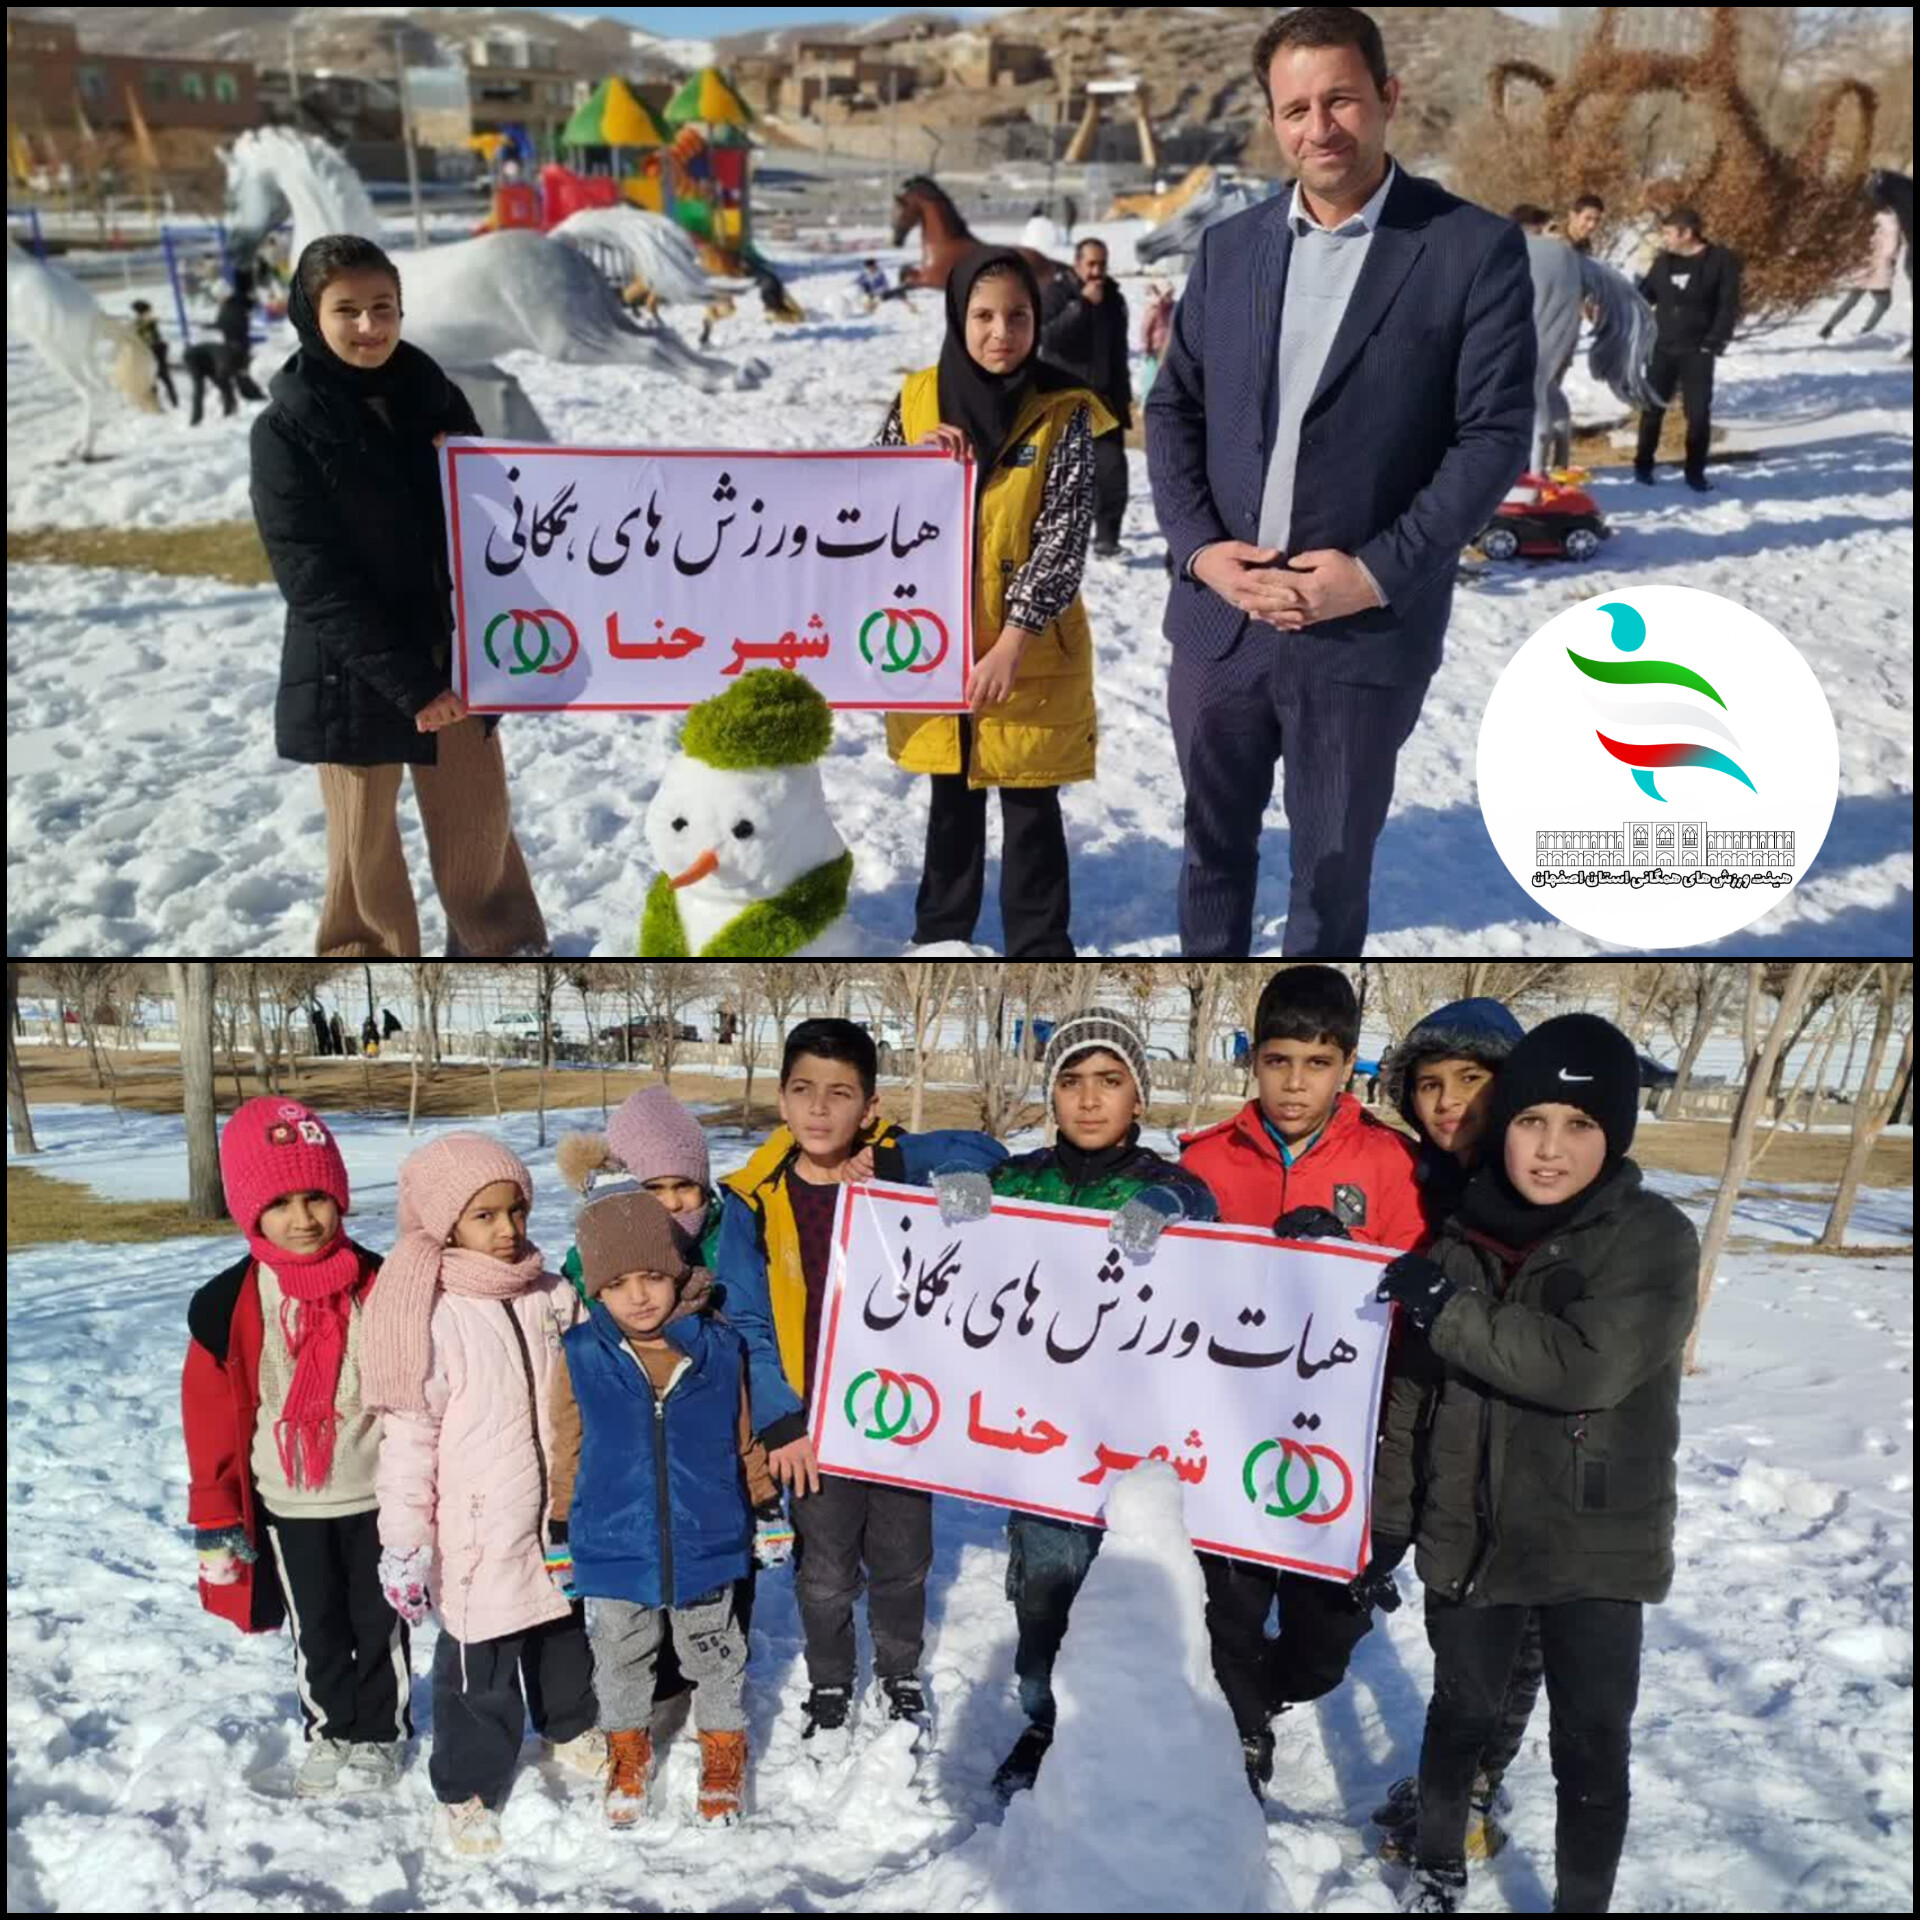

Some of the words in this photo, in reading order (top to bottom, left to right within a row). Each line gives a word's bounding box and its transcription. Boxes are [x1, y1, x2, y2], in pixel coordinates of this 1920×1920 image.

[484, 467, 579, 576] همگانی
[587, 489, 661, 576] های
[673, 472, 808, 576] ورزش
[605, 611, 706, 661] حنا
[720, 613, 831, 675] شهر
[862, 1215, 962, 1331] همگانی
[962, 1259, 1040, 1349] های
[1045, 1248, 1202, 1364] ورزش
[966, 1390, 1068, 1455] حنا
